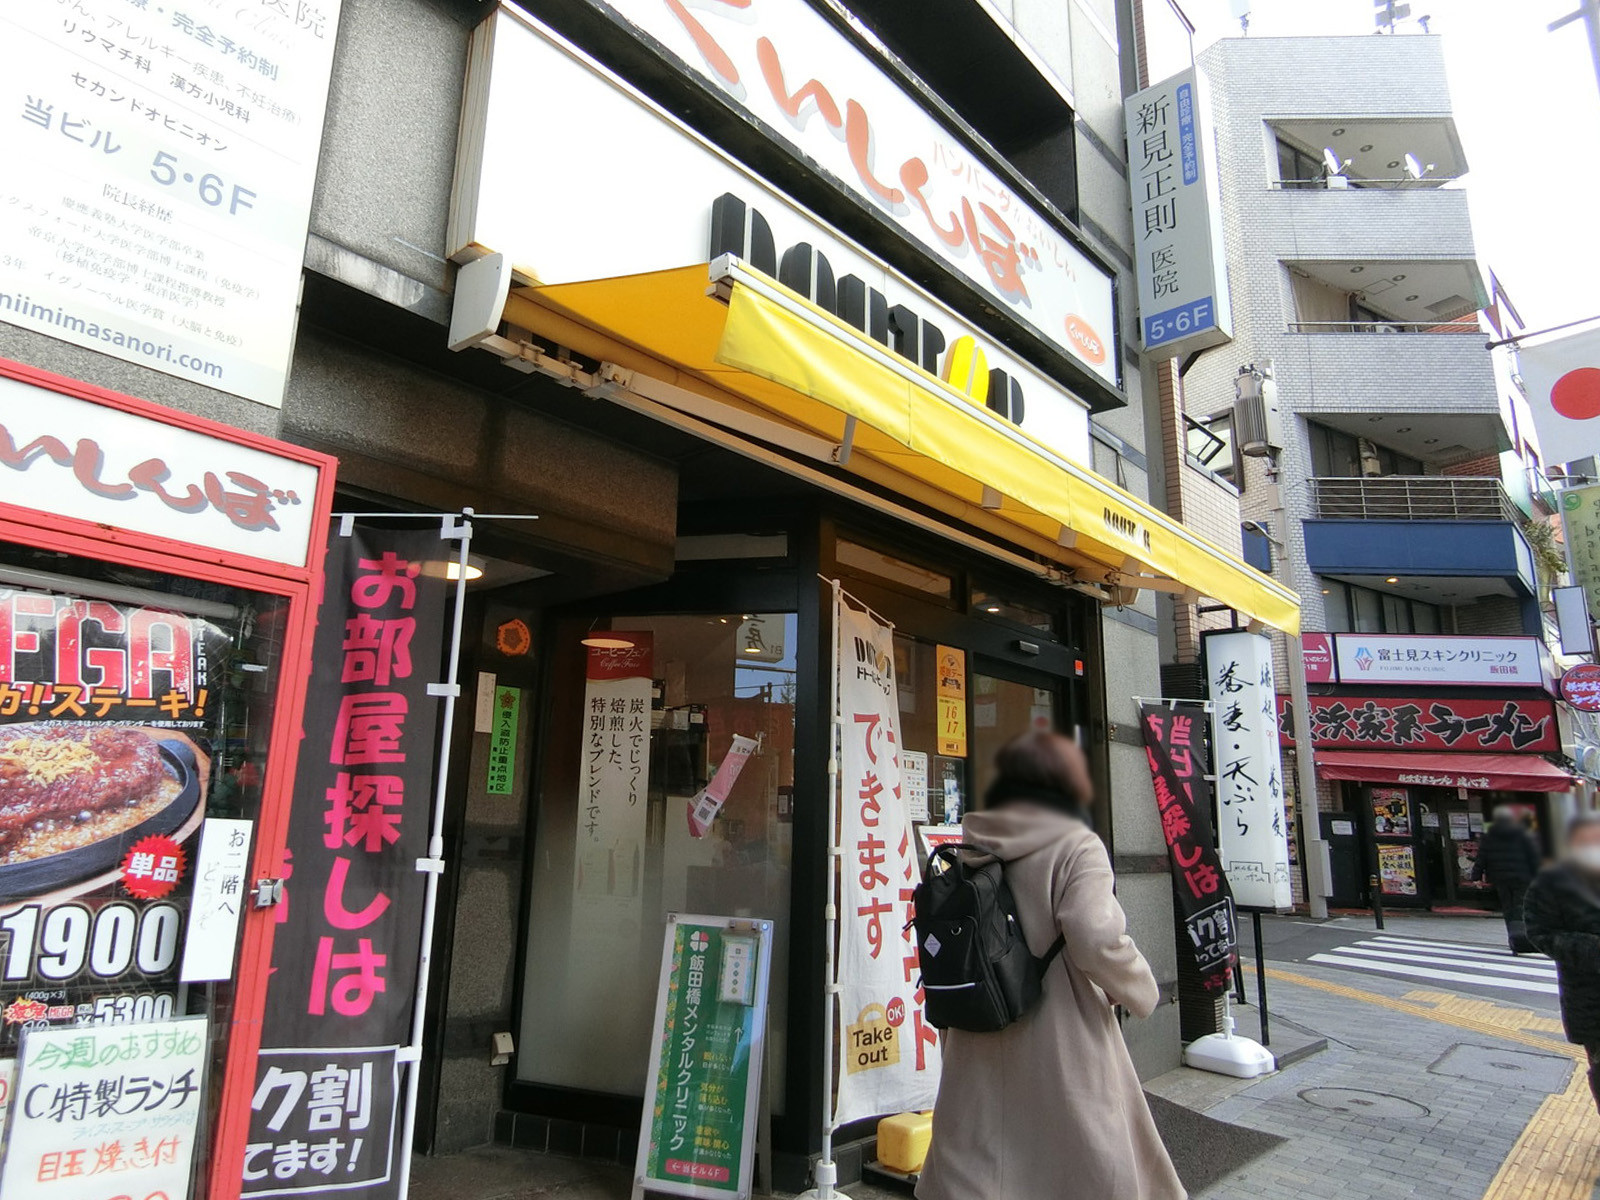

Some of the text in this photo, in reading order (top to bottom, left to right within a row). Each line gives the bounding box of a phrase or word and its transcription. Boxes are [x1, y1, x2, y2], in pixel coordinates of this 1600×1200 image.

[62, 19, 251, 125] リウマチ科 漢方小児科
[71, 71, 229, 153] セカンドオピニオン
[21, 95, 258, 216] 当ビル 5・6F
[1136, 94, 1180, 300] 新見正則 医院
[0, 292, 225, 379] niimimasanori.com
[1377, 648, 1518, 663] 富士見スキンクリニック
[1490, 665, 1519, 675] 飯田橋
[584, 697, 606, 842] 特別なブレンドです。
[609, 697, 627, 771] 焙煎した、
[628, 697, 645, 806] 炭火でじっくり
[308, 552, 422, 1016] お部屋探しは
[127, 852, 180, 882] 単品
[853, 713, 893, 959] できます
[1, 903, 181, 980] 1900
[28, 1029, 201, 1070] 今週のおすすめ
[670, 954, 705, 1151] 飯田橋メンタルクリニック
[853, 1026, 893, 1048] Take
[858, 1046, 889, 1066] out
[24, 1068, 199, 1123] C特製ランチ
[37, 1135, 182, 1182] 目玉焼き付
